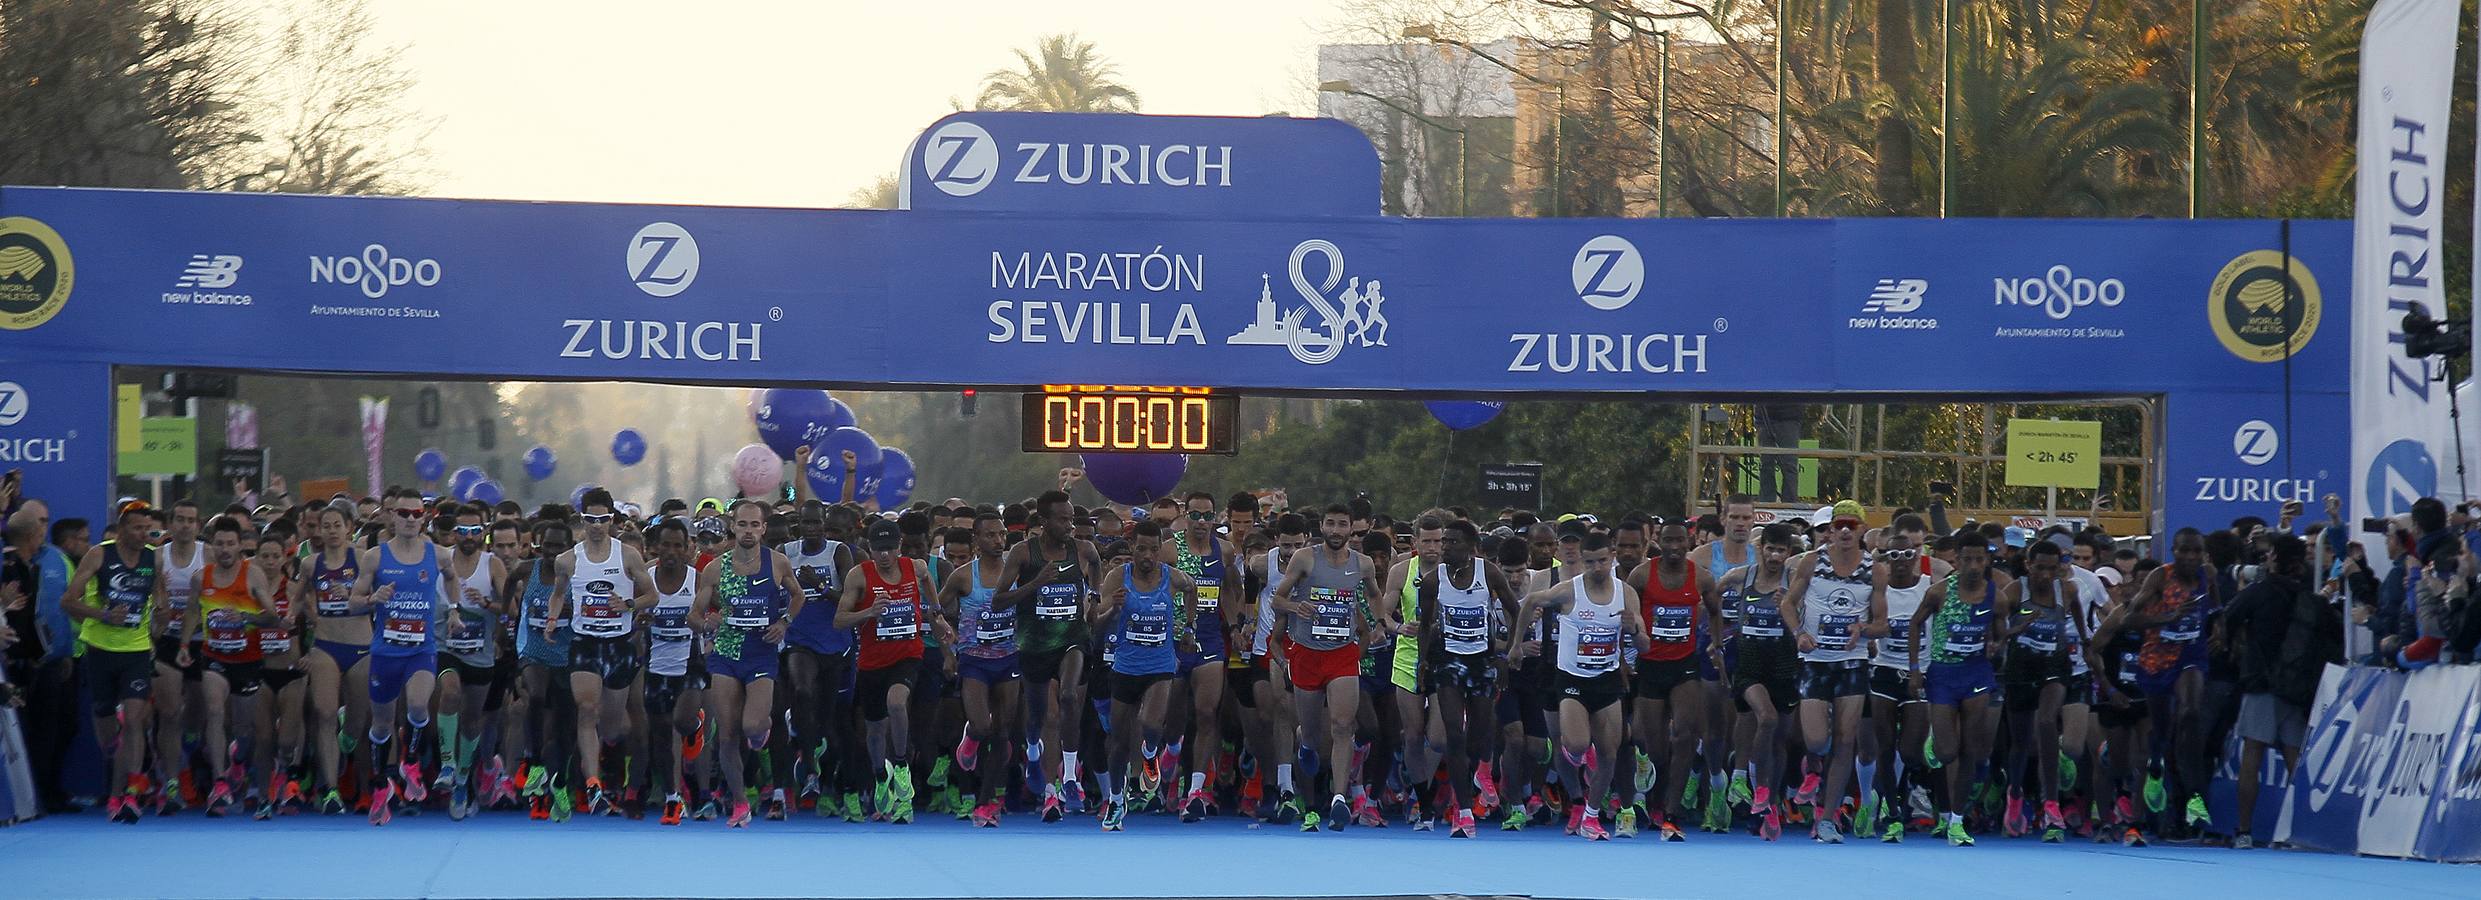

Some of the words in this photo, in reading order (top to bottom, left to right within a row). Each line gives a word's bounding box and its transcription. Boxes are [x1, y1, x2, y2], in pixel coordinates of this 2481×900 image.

[1013, 142, 1233, 187] ZURICH
[990, 244, 1205, 292] MARATÓN
[161, 292, 191, 304] new
[193, 291, 252, 305] balance
[987, 299, 1207, 346] SEVILLA
[1849, 318, 1878, 329] new
[1879, 316, 1938, 329] balance
[560, 319, 763, 361] ZURICH
[1507, 333, 1709, 373] ZURICH
[1044, 396, 1209, 450] 0:00:00
[2039, 451, 2055, 462] 2h
[1487, 481, 1499, 491] 3h
[1506, 483, 1518, 491] 3h
[2194, 477, 2316, 503] ZURICH
[1050, 586, 1075, 594] ZURICH
[889, 605, 913, 613] ZURICH
[1460, 619, 1470, 627] 12
[1670, 619, 1677, 627] 2
